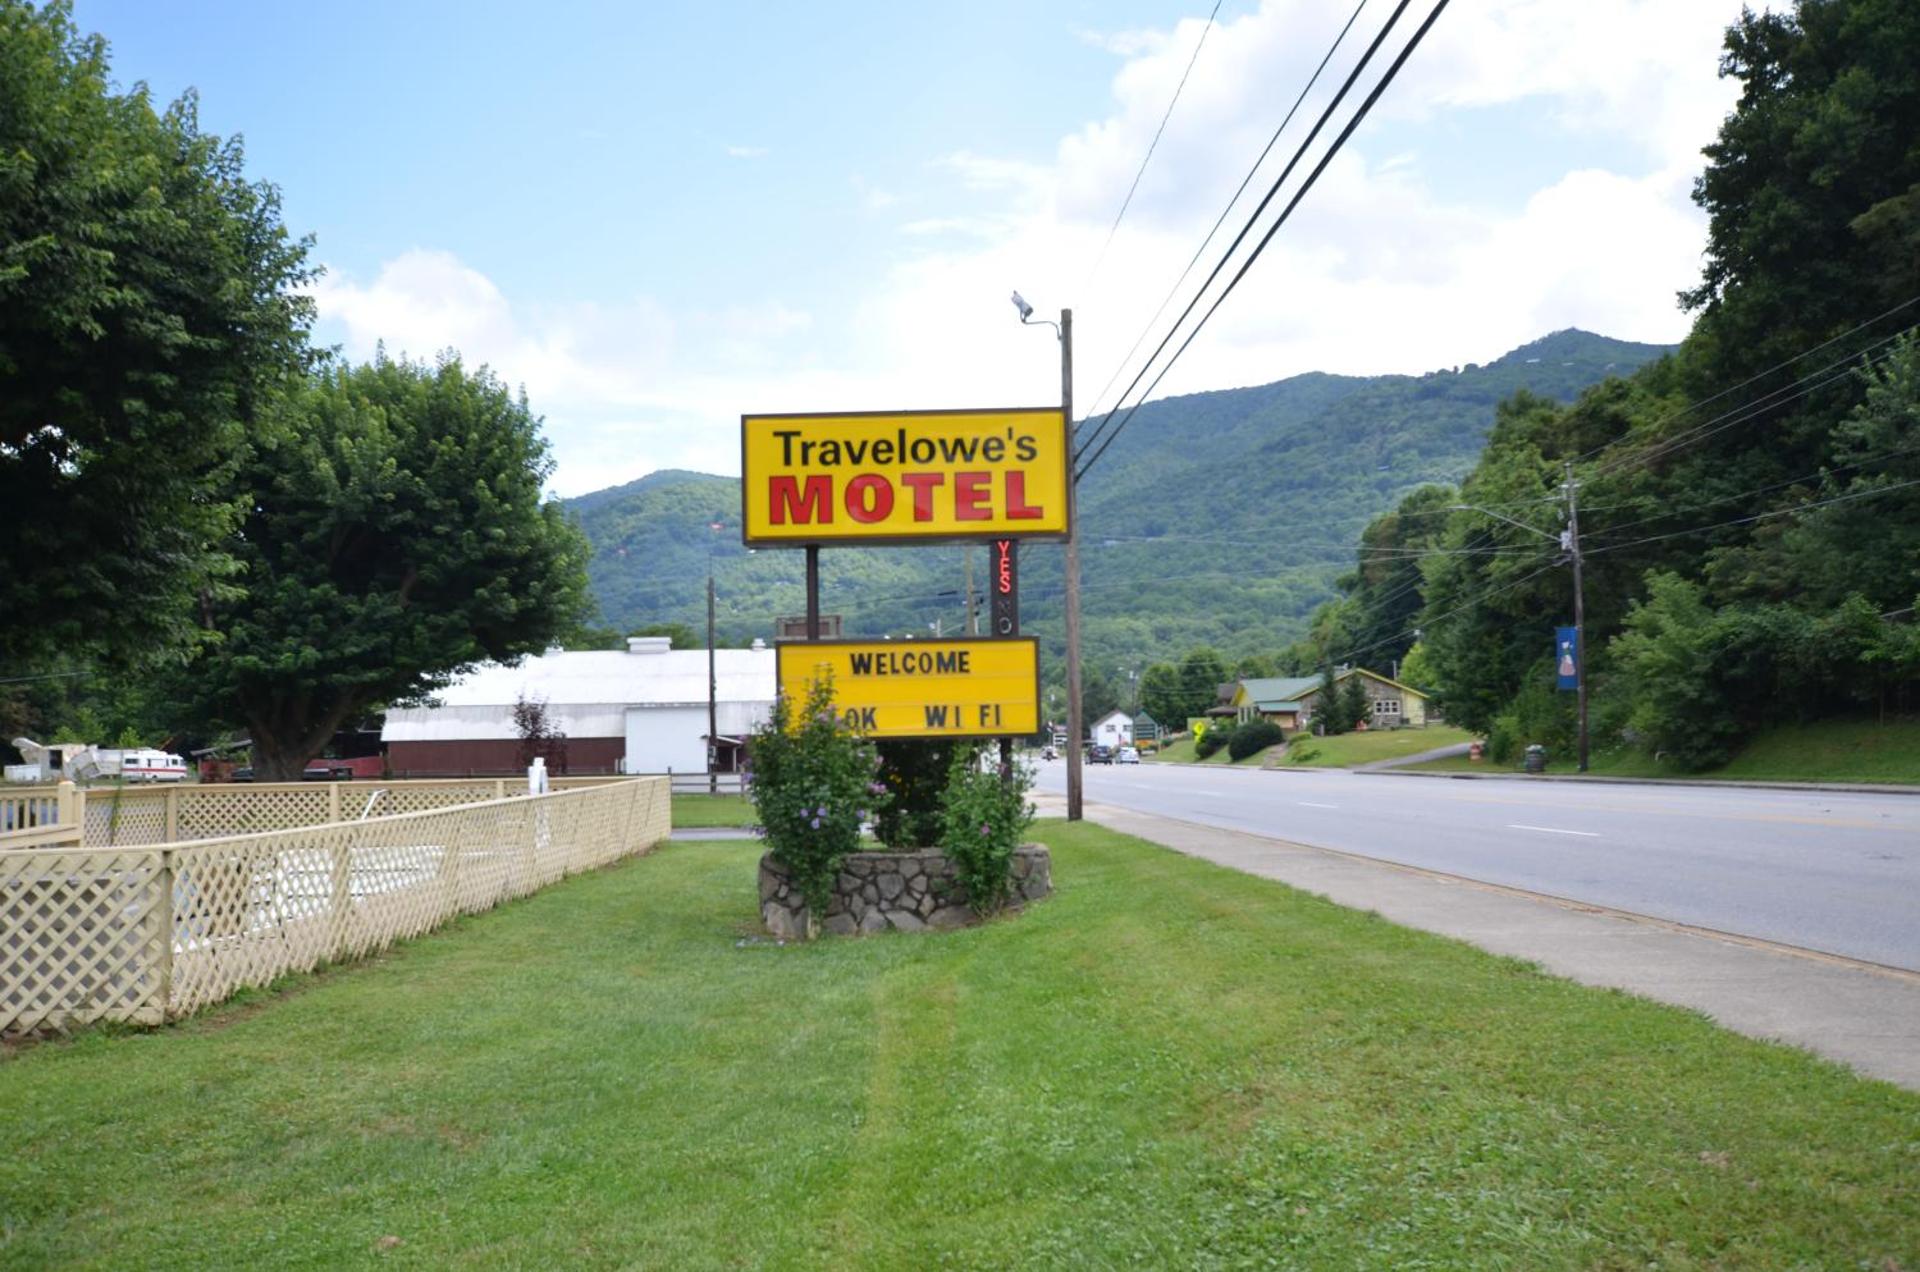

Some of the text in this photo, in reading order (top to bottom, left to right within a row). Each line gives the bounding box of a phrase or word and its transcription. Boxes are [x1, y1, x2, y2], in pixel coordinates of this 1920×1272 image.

[773, 427, 1038, 466] Travelowe's
[768, 470, 1044, 525] MOTEL
[997, 540, 1011, 593] YES
[850, 651, 970, 675] WELCOME
